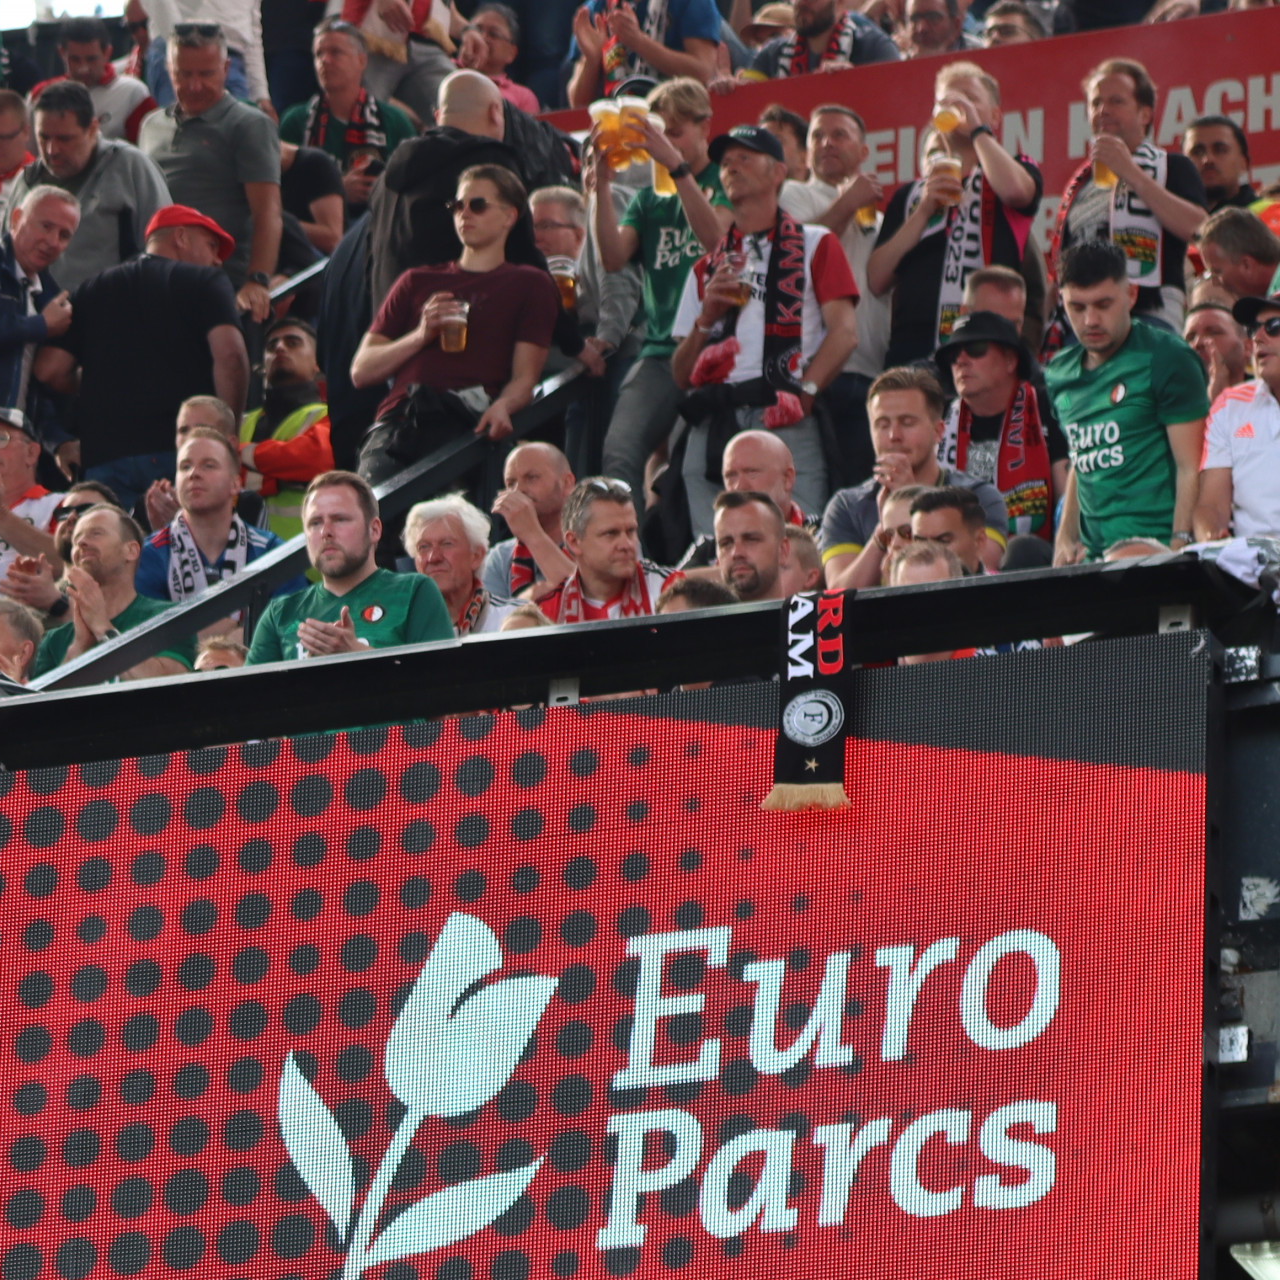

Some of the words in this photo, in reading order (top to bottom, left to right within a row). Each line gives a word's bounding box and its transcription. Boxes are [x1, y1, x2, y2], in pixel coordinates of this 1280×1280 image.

[860, 106, 1045, 186] EIN
[1065, 419, 1121, 450] Euro
[612, 926, 1062, 1090] Euro
[595, 1099, 1059, 1251] Parcs
